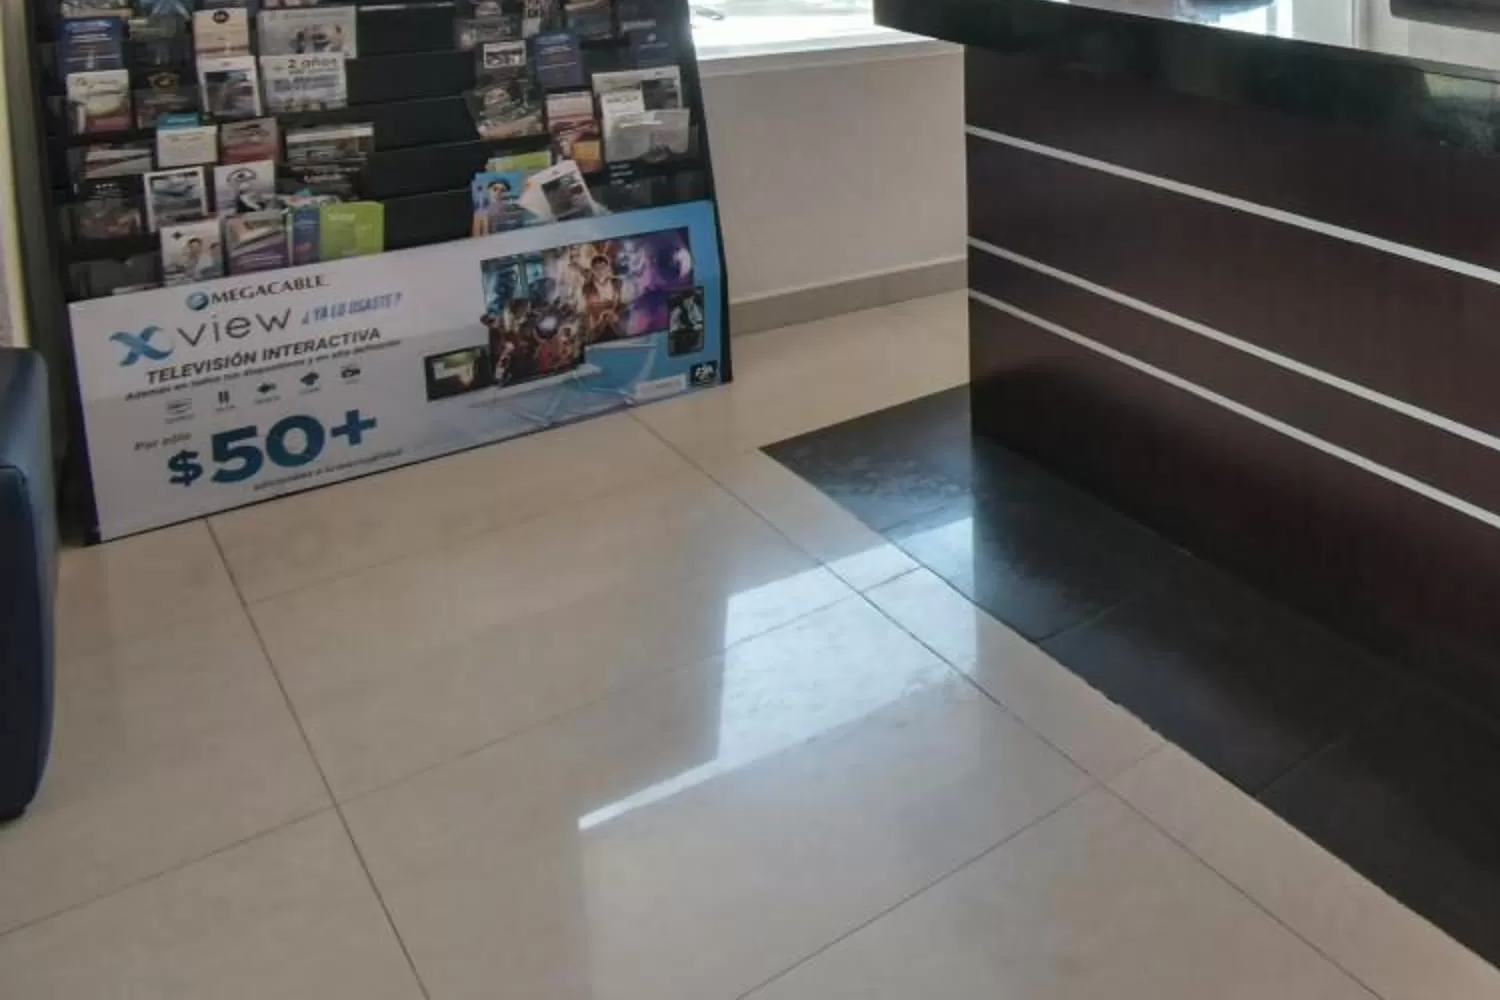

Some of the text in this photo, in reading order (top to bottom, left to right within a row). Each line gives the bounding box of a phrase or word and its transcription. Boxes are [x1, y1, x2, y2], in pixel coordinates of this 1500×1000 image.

[209, 275, 329, 305] MEGACABLE
[147, 327, 381, 385] TELEVISIÓN INTERACTIVA
[167, 408, 377, 487] $50+
